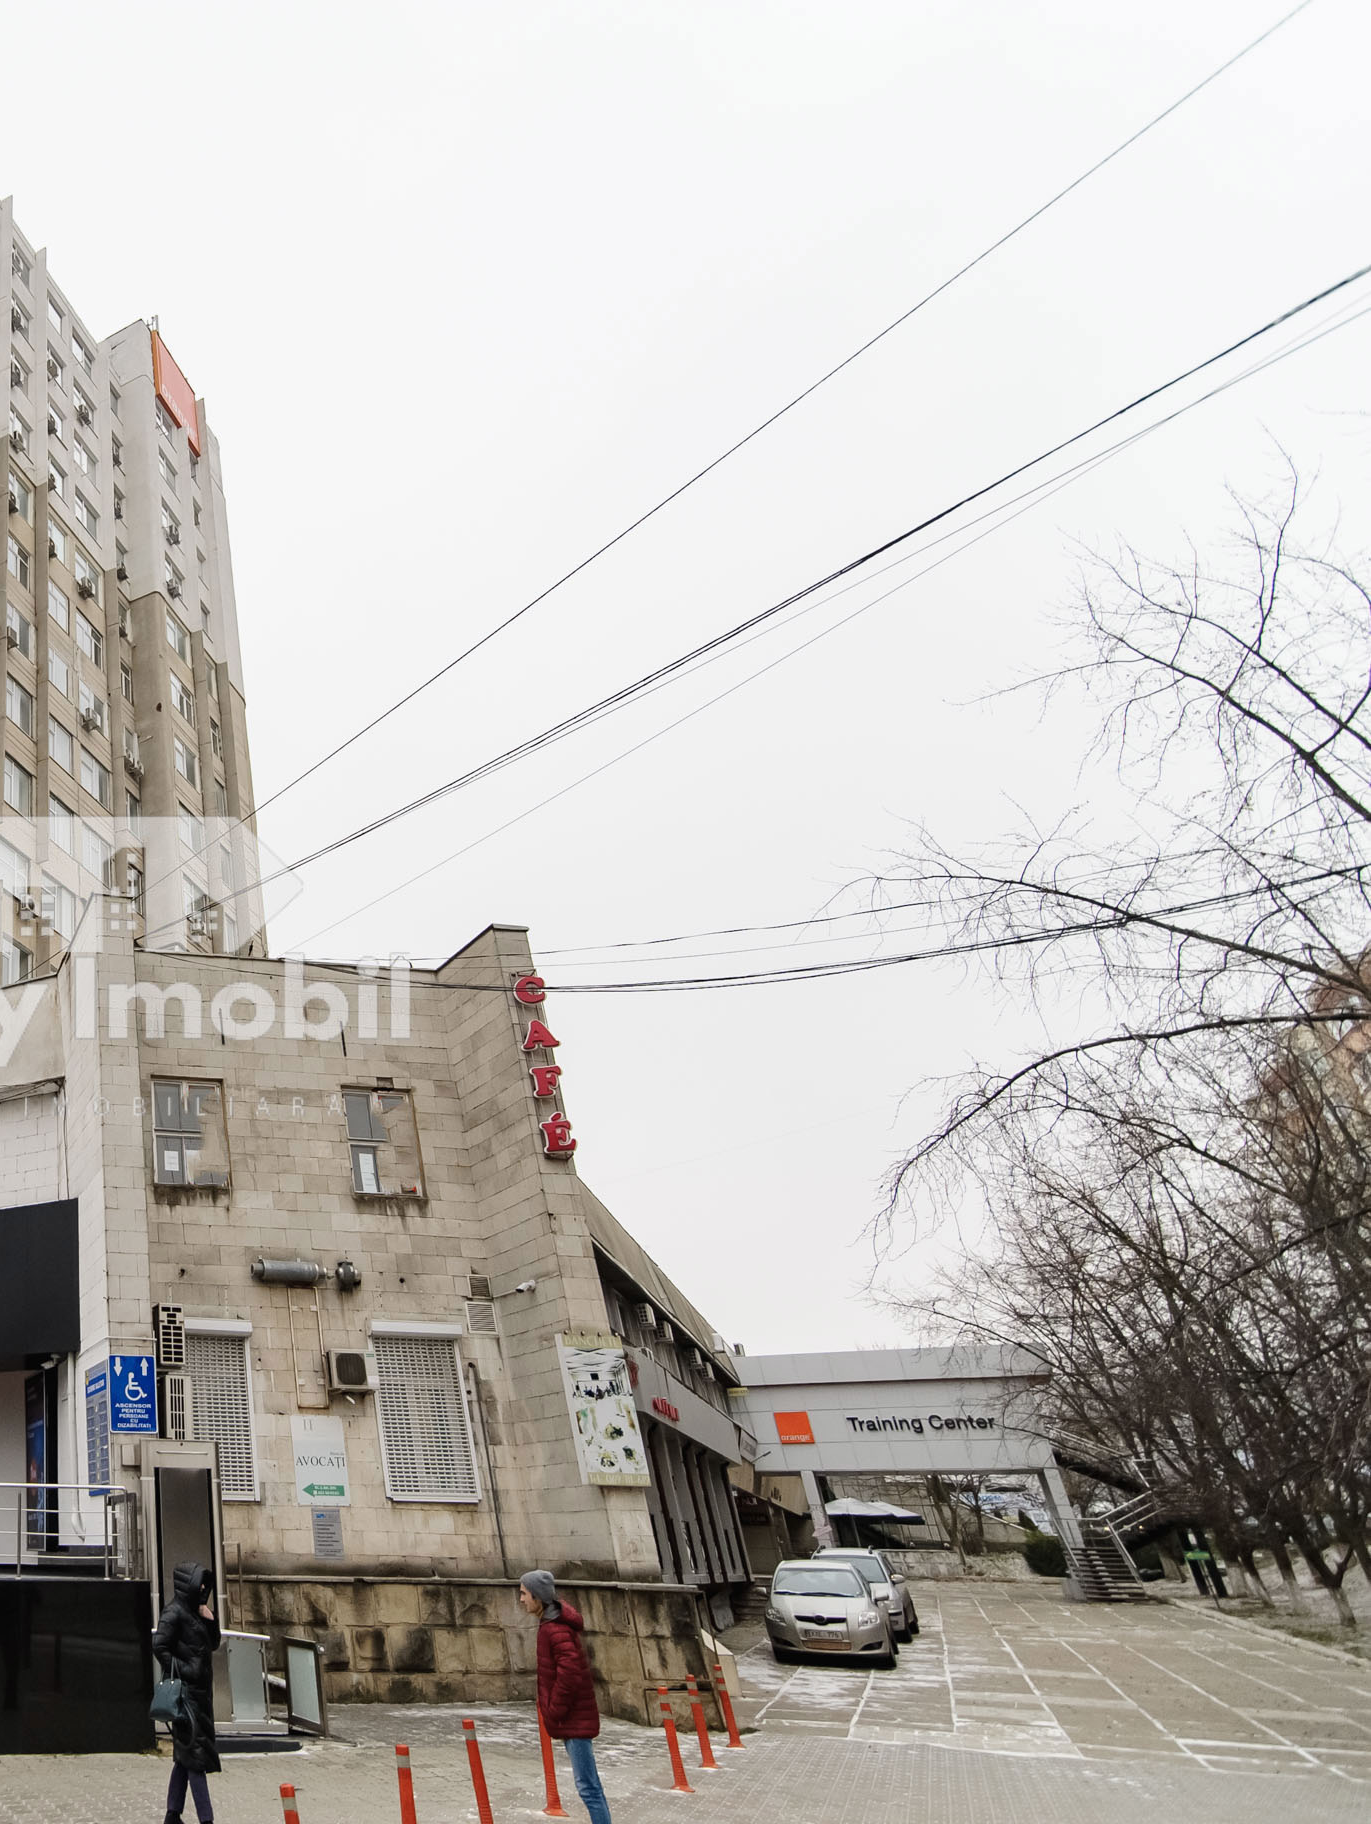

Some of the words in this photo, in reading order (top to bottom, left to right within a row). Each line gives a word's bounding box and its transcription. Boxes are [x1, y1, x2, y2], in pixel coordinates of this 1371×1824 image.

[514, 976, 577, 1153] CAFÉ
[846, 1416, 924, 1434] Training
[928, 1414, 995, 1430] Center
[780, 1434, 810, 1443] orange
